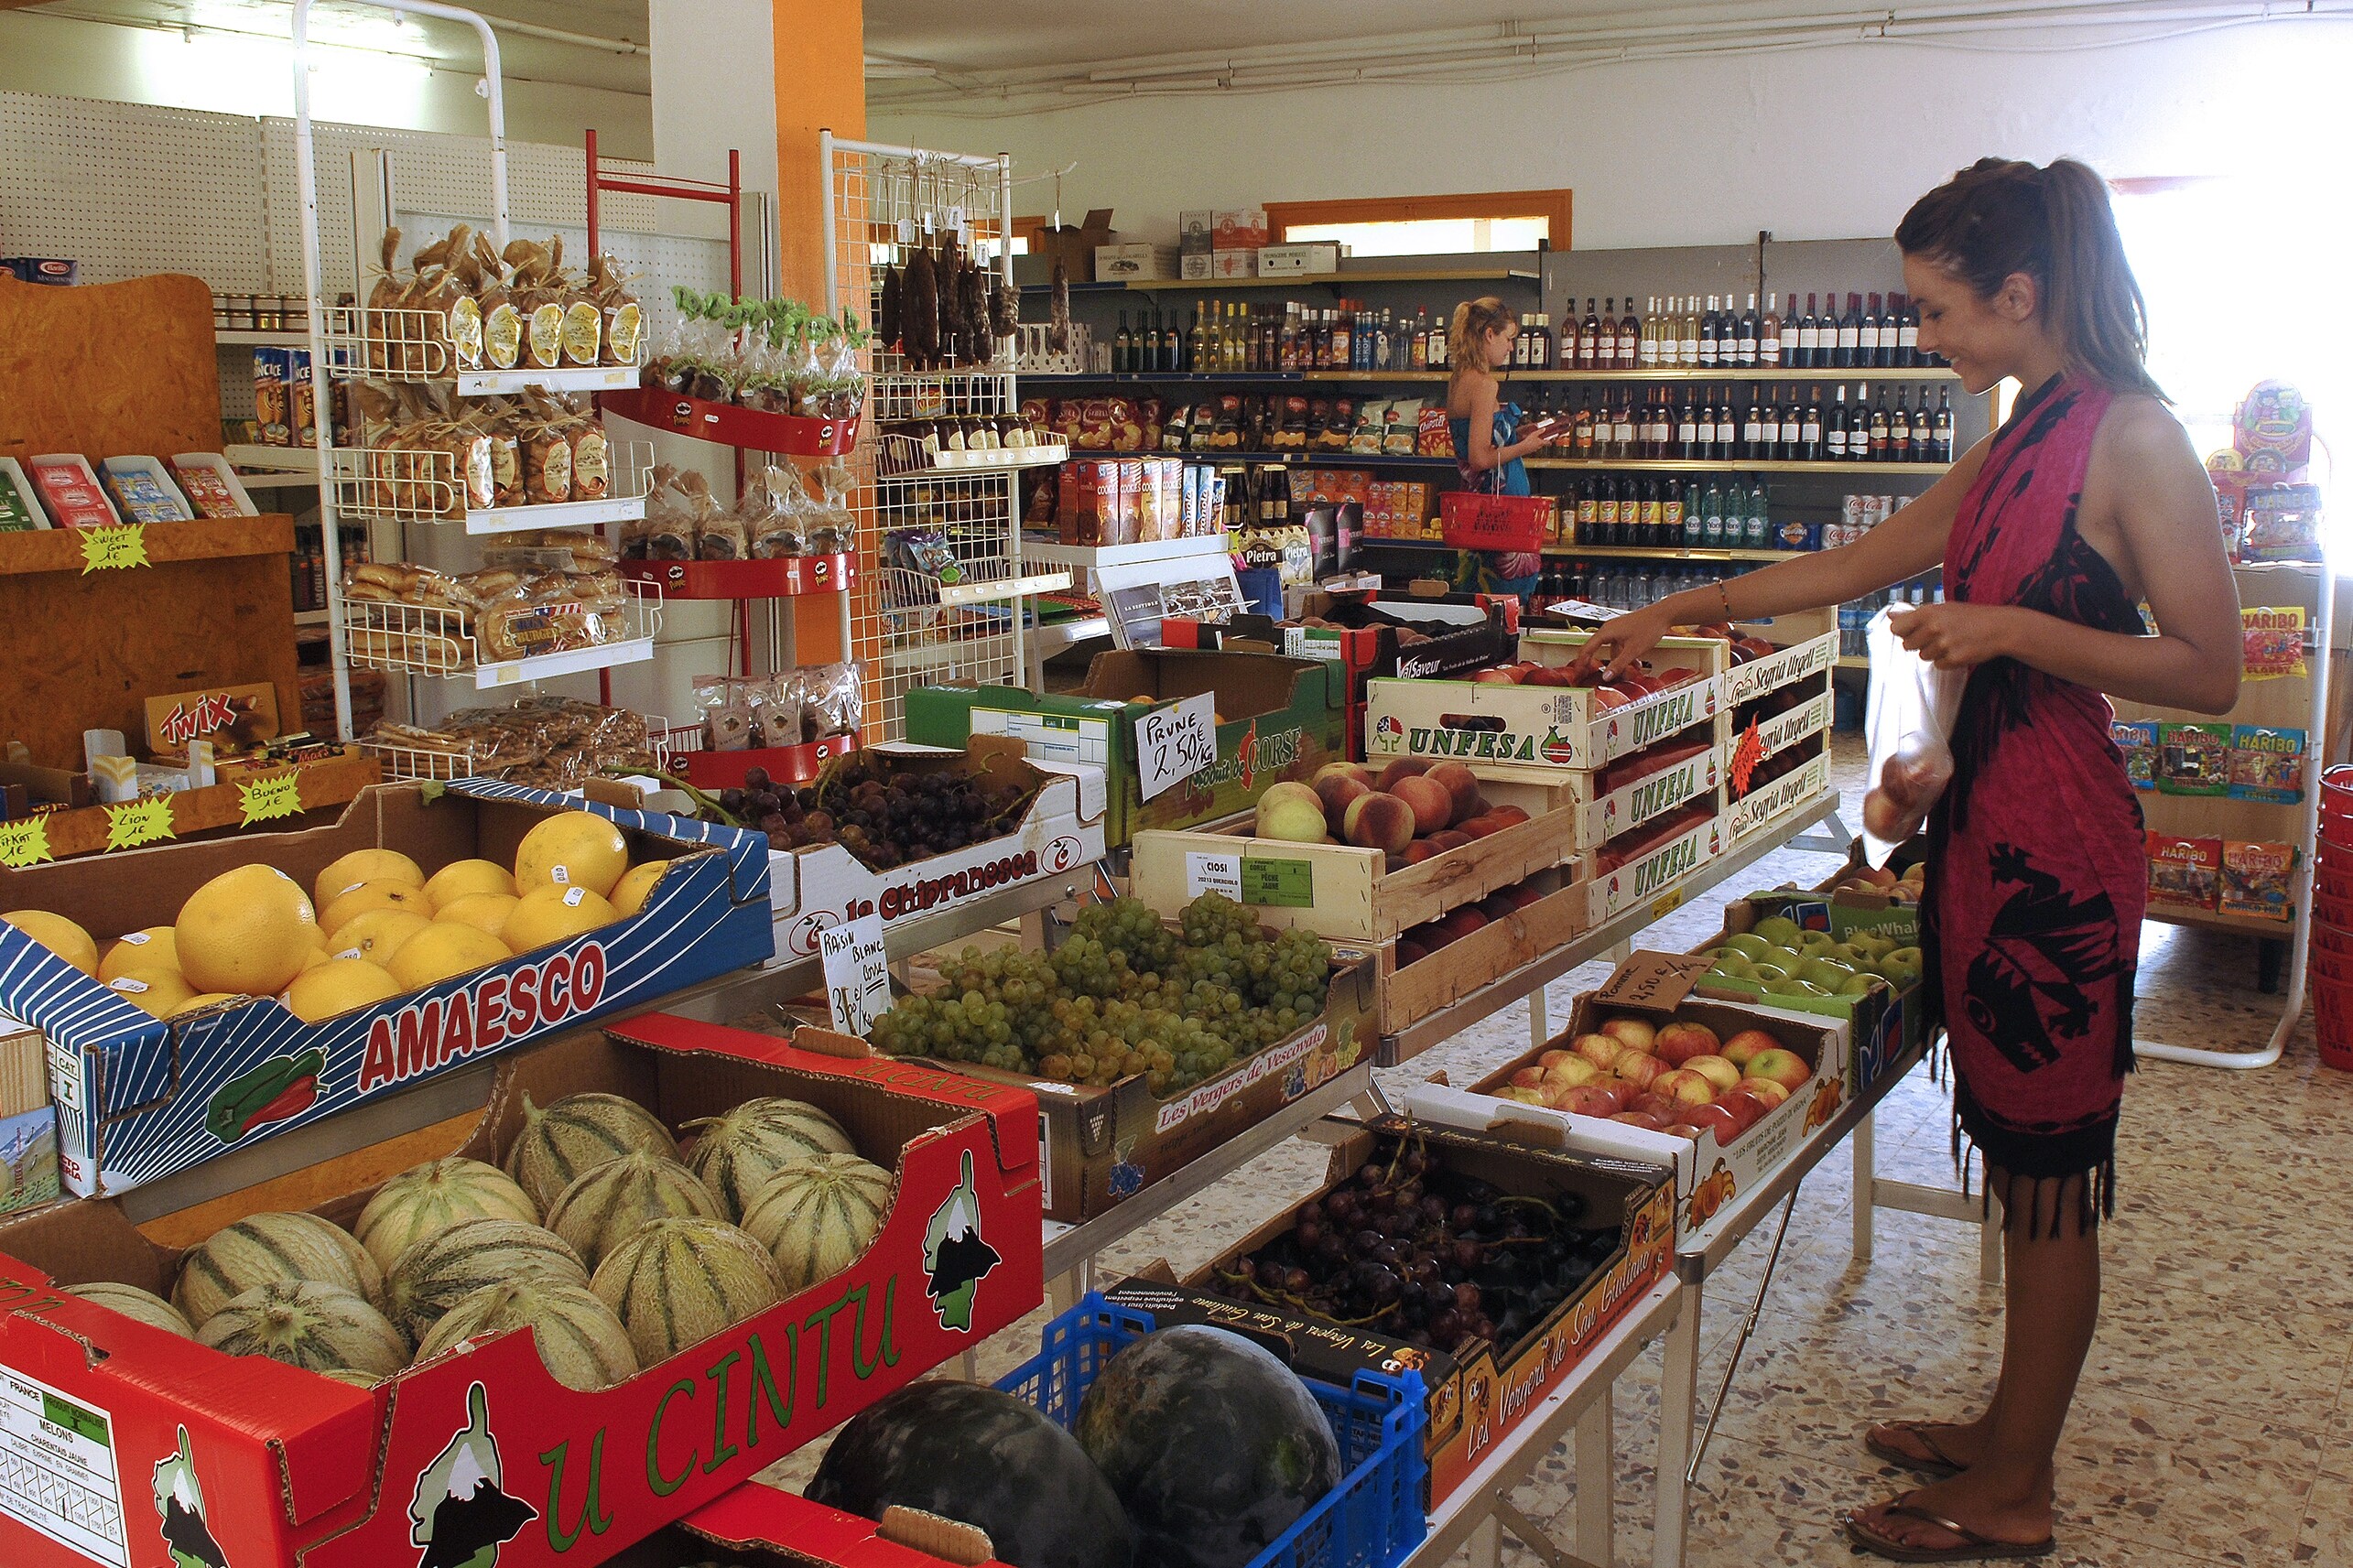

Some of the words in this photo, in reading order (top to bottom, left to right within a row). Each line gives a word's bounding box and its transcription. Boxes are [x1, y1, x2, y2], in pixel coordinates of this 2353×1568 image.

[92, 534, 130, 545] SWEET
[1247, 550, 1276, 563] Pietra
[1285, 547, 1307, 561] Pietra
[1632, 691, 1693, 745] UNFESA
[1146, 712, 1197, 746] PRUNE
[2109, 729, 2149, 741] ARIBO
[2167, 731, 2219, 744] HARIBO
[1248, 726, 1302, 773] CORSE
[1410, 729, 1534, 761] UNFESA
[1758, 723, 1784, 757] egrià
[2239, 735, 2296, 752] HARIBO
[1631, 763, 1694, 822] UNFESA
[2161, 847, 2207, 861] HARIBO
[2228, 852, 2283, 868] HARIBO
[1207, 861, 1228, 873] CIOSI
[1634, 835, 1697, 897] UNFESA
[879, 849, 1037, 921] Chipranesca
[1844, 920, 1922, 939] BlueWhal
[852, 940, 885, 964] BLANC
[357, 943, 606, 1095] AMAESCO
[1160, 1104, 1187, 1128] Les
[1192, 1075, 1243, 1110] Vergers
[1247, 1062, 1263, 1082] de
[1267, 1028, 1327, 1070] Vescovato
[1142, 1295, 1184, 1303] agriculture
[1153, 1303, 1176, 1311] Produits
[1252, 1311, 1283, 1330] San
[1285, 1320, 1304, 1333] de
[1306, 1324, 1358, 1349] Vergers
[1361, 1338, 1387, 1357] Les
[1468, 1417, 1490, 1462] Les
[1500, 1357, 1546, 1426] Vergers
[1551, 1330, 1567, 1372] de
[1571, 1301, 1598, 1346] San
[1601, 1249, 1653, 1314] Giuliano
[10, 1380, 40, 1401] FRANCE
[46, 1398, 71, 1415] PRODUIT
[539, 1441, 613, 1552] U
[645, 1272, 904, 1498] CINTU
[39, 1420, 74, 1444] MELONS
[71, 1417, 81, 1431] I
[31, 1433, 68, 1457] CHARENTAIS
[68, 1448, 88, 1466] JAUNE
